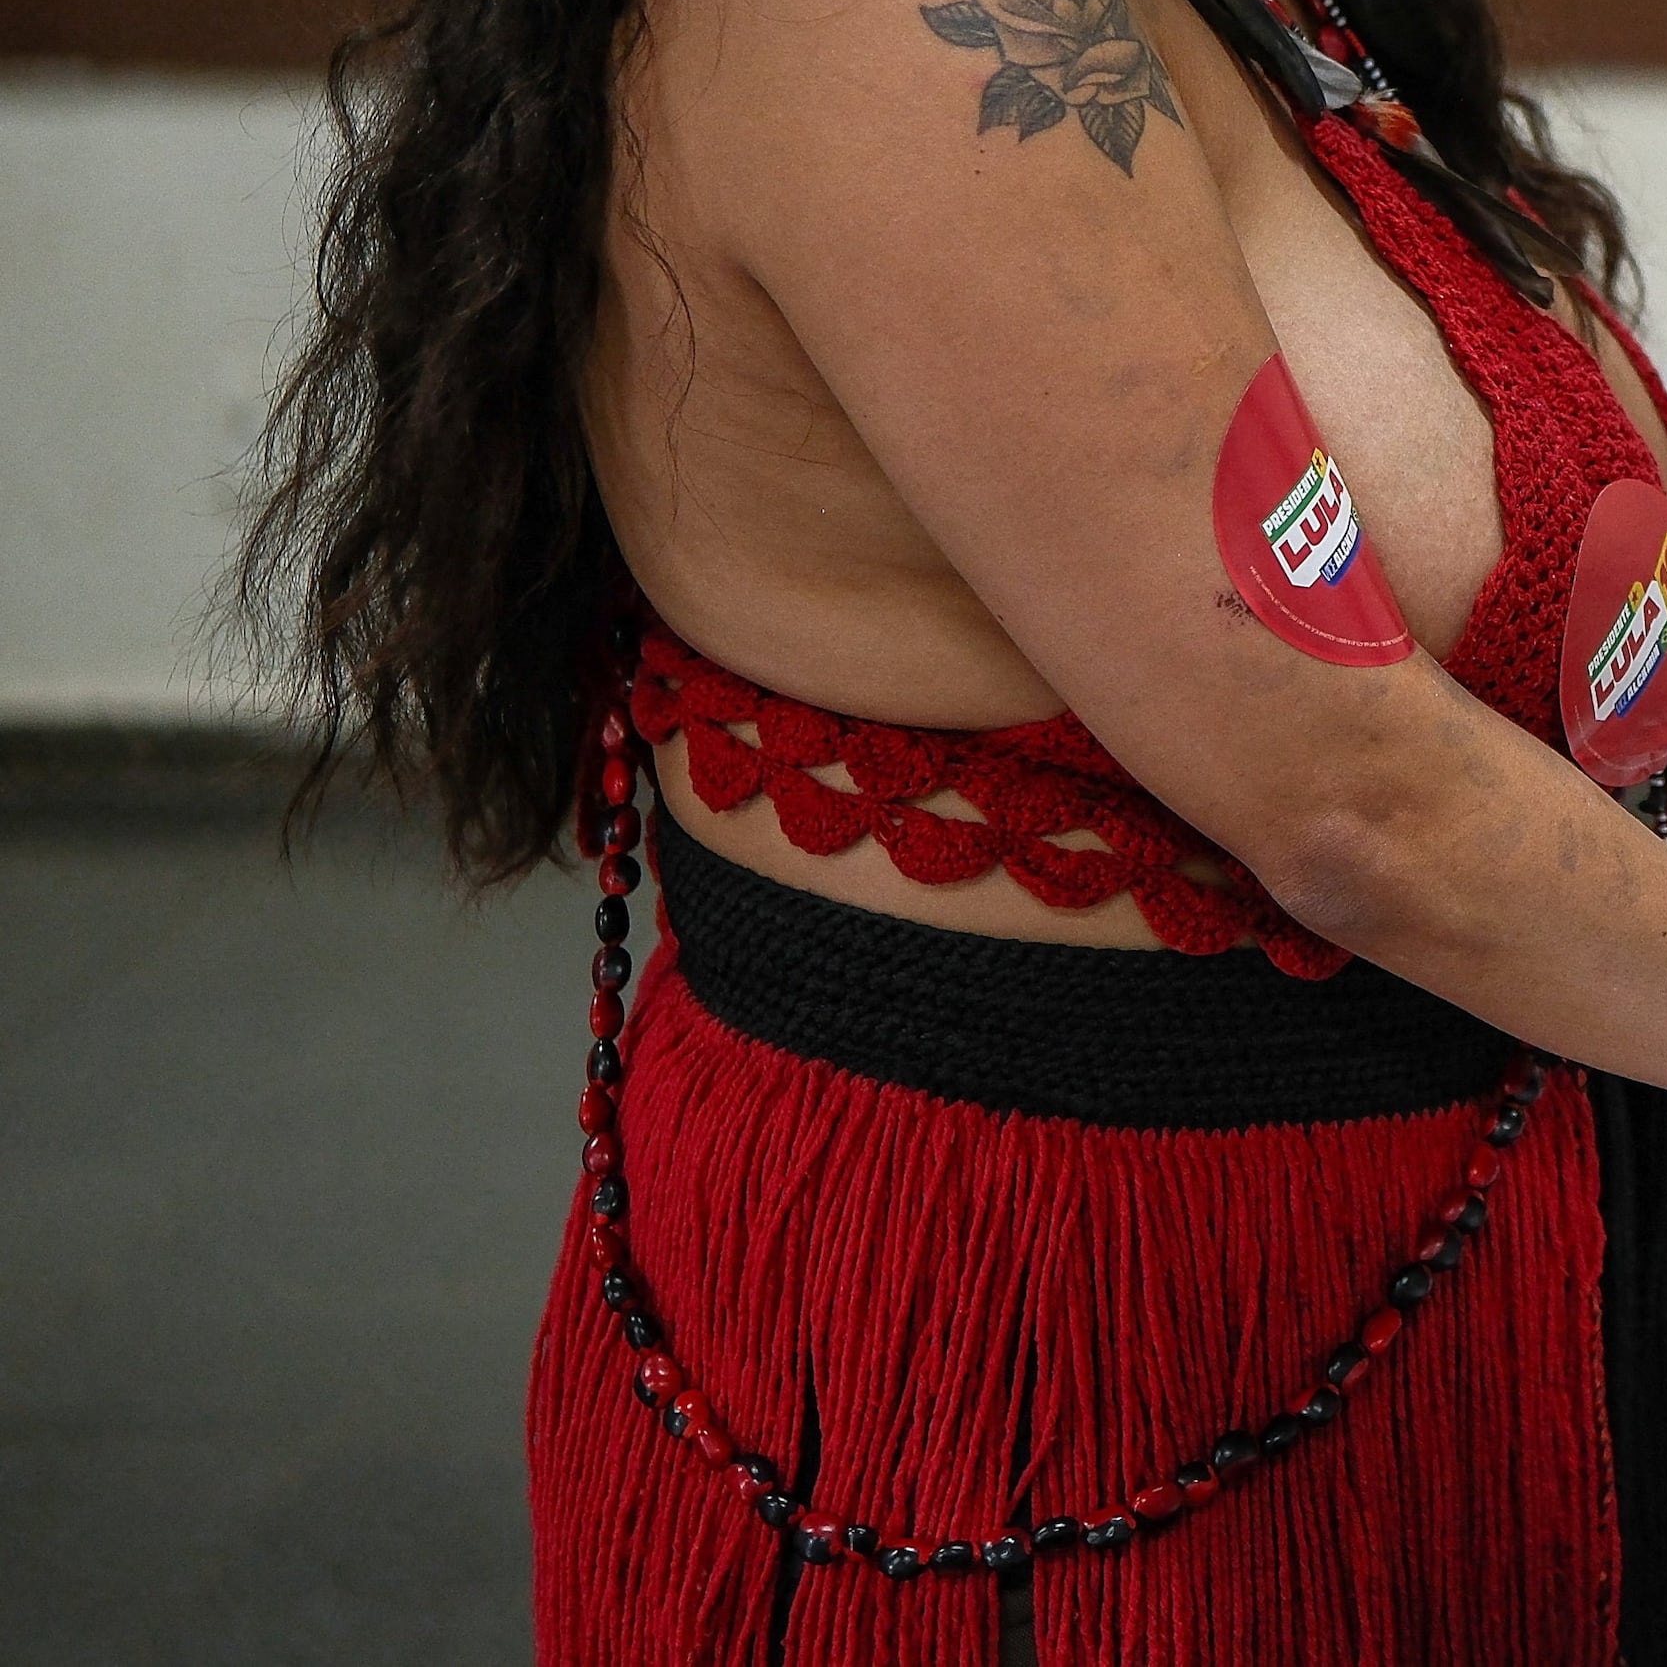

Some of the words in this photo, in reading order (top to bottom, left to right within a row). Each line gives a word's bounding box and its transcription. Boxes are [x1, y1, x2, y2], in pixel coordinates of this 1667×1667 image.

[1261, 464, 1319, 537] PRESIDENTE
[1278, 467, 1344, 574] LULA
[1333, 519, 1358, 566] ALCK
[1587, 602, 1632, 677] PRESIDENTE
[1594, 596, 1661, 709] LULA
